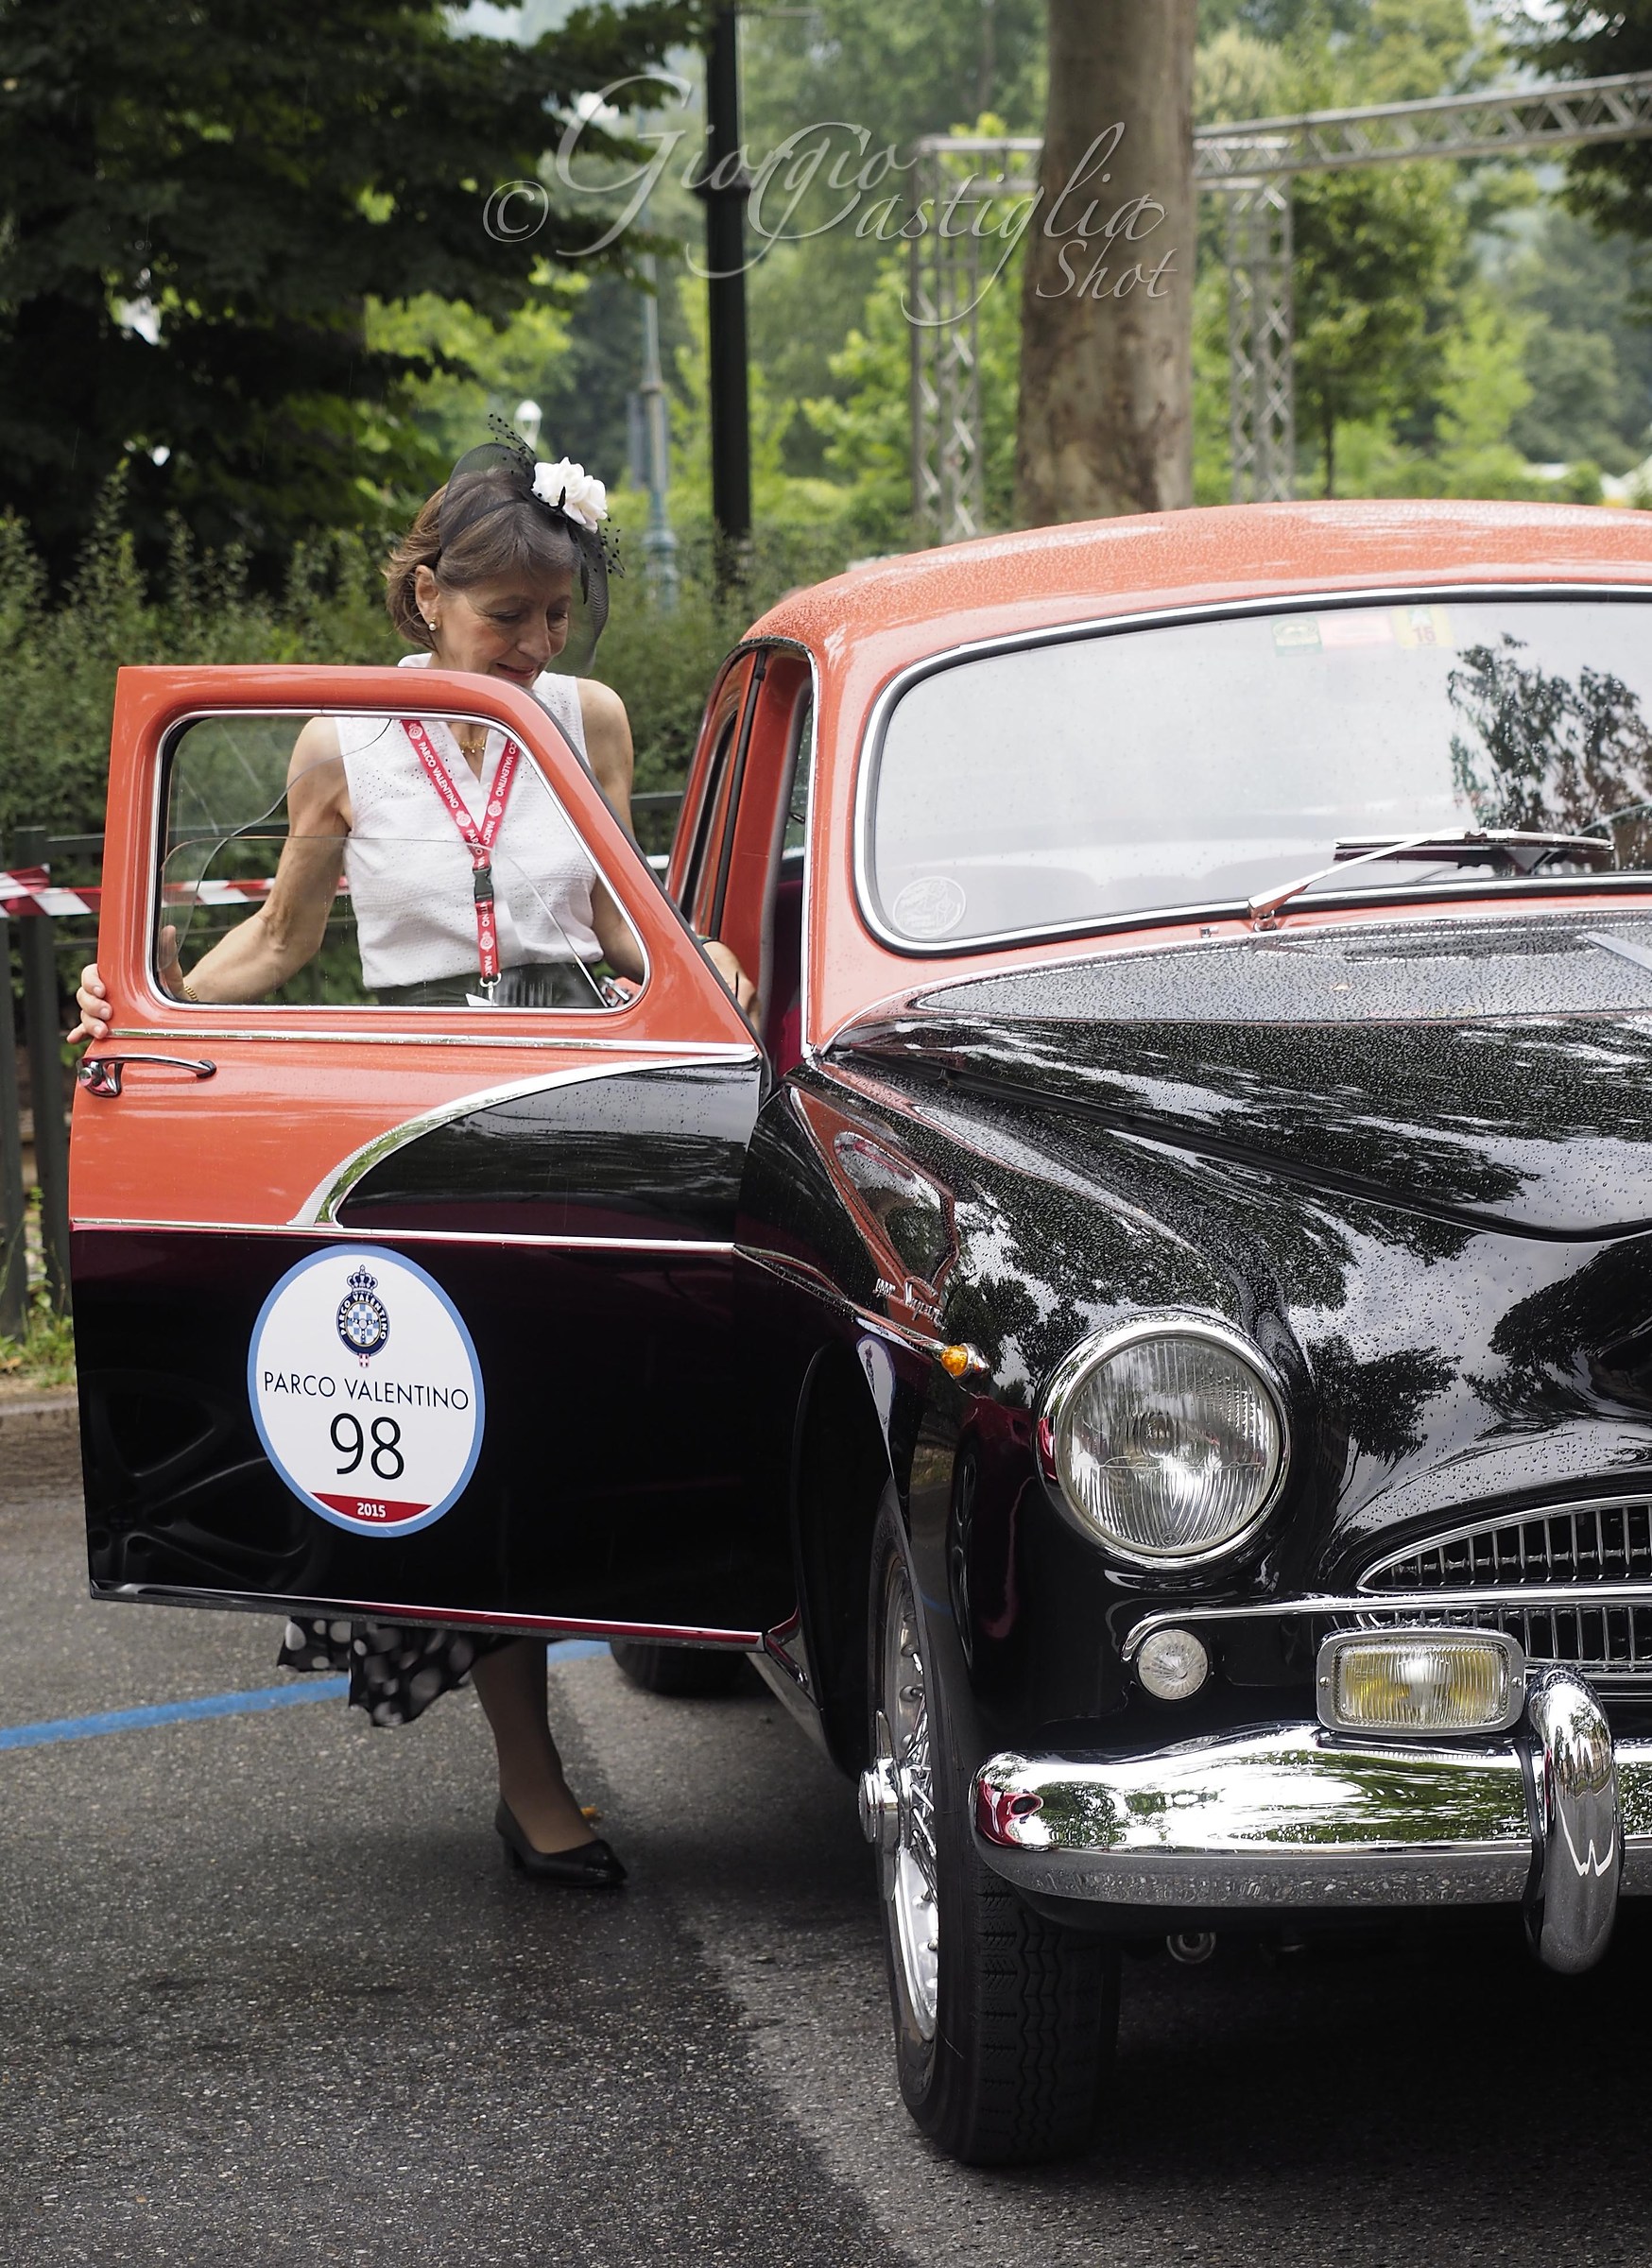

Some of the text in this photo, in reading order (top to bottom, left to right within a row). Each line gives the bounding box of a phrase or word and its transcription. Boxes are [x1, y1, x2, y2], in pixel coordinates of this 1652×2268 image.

[418, 741, 459, 809] PARCO VALENTINO
[495, 756, 514, 798] VALENTINO
[338, 1294, 388, 1340] PARCO VALENTINO
[263, 1371, 470, 1410] PARCO VALENTINO
[330, 1413, 405, 1481] 98
[356, 1502, 387, 1518] 2015
